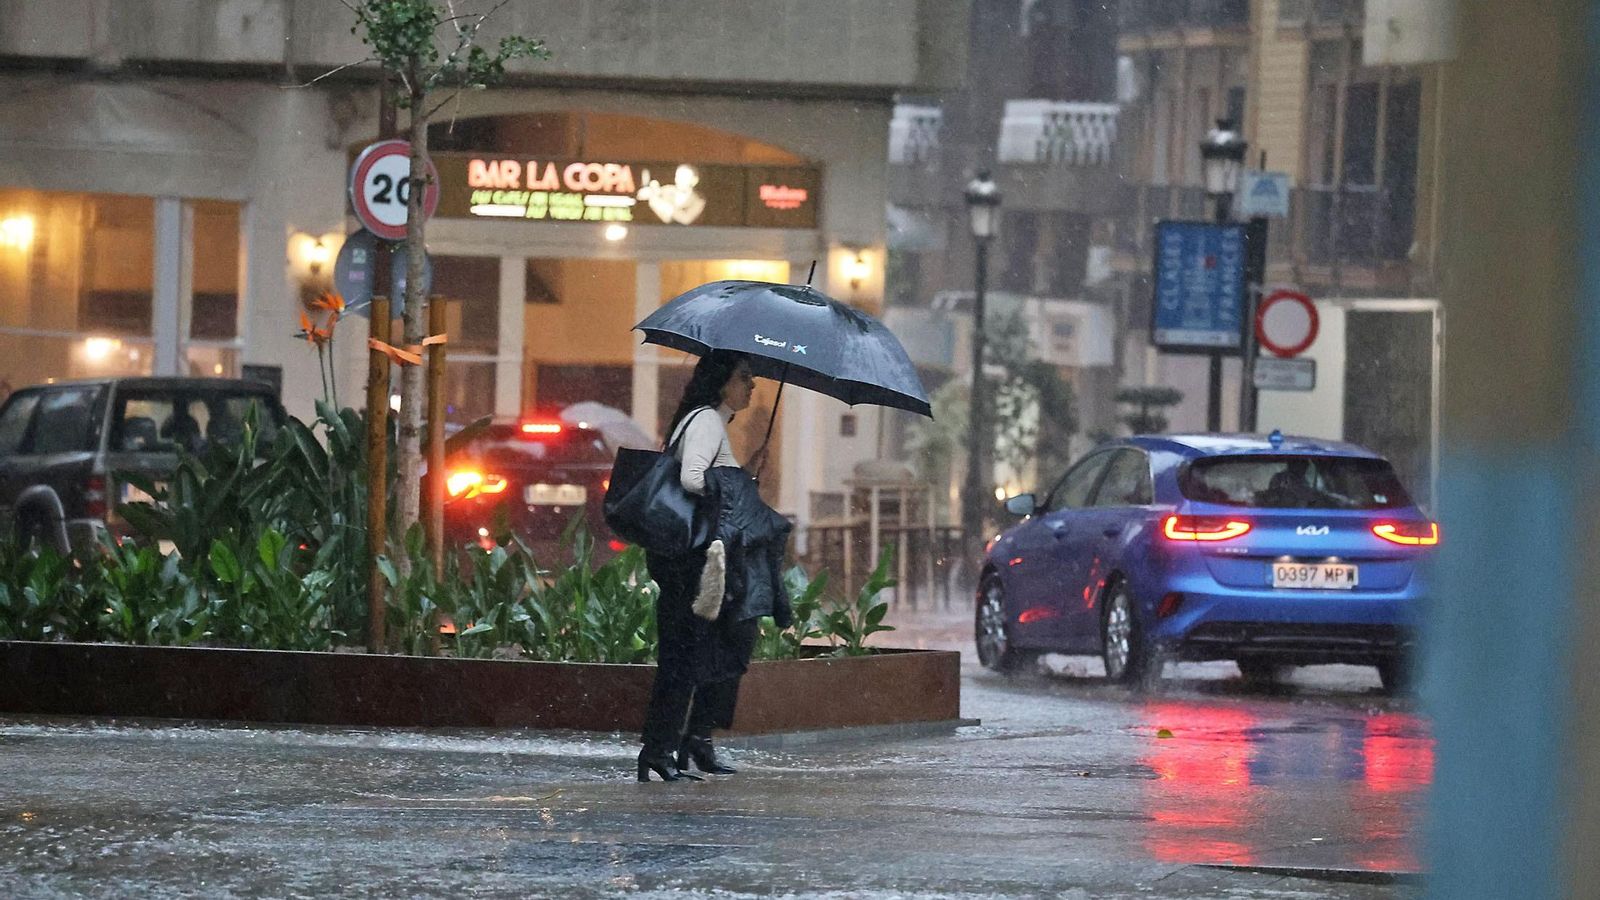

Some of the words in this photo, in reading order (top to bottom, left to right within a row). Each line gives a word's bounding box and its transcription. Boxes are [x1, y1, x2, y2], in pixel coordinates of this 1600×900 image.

[373, 174, 411, 206] 20
[468, 159, 521, 189] BAR
[526, 160, 560, 190] LA
[563, 162, 635, 193] COPA
[1277, 566, 1318, 581] 0397
